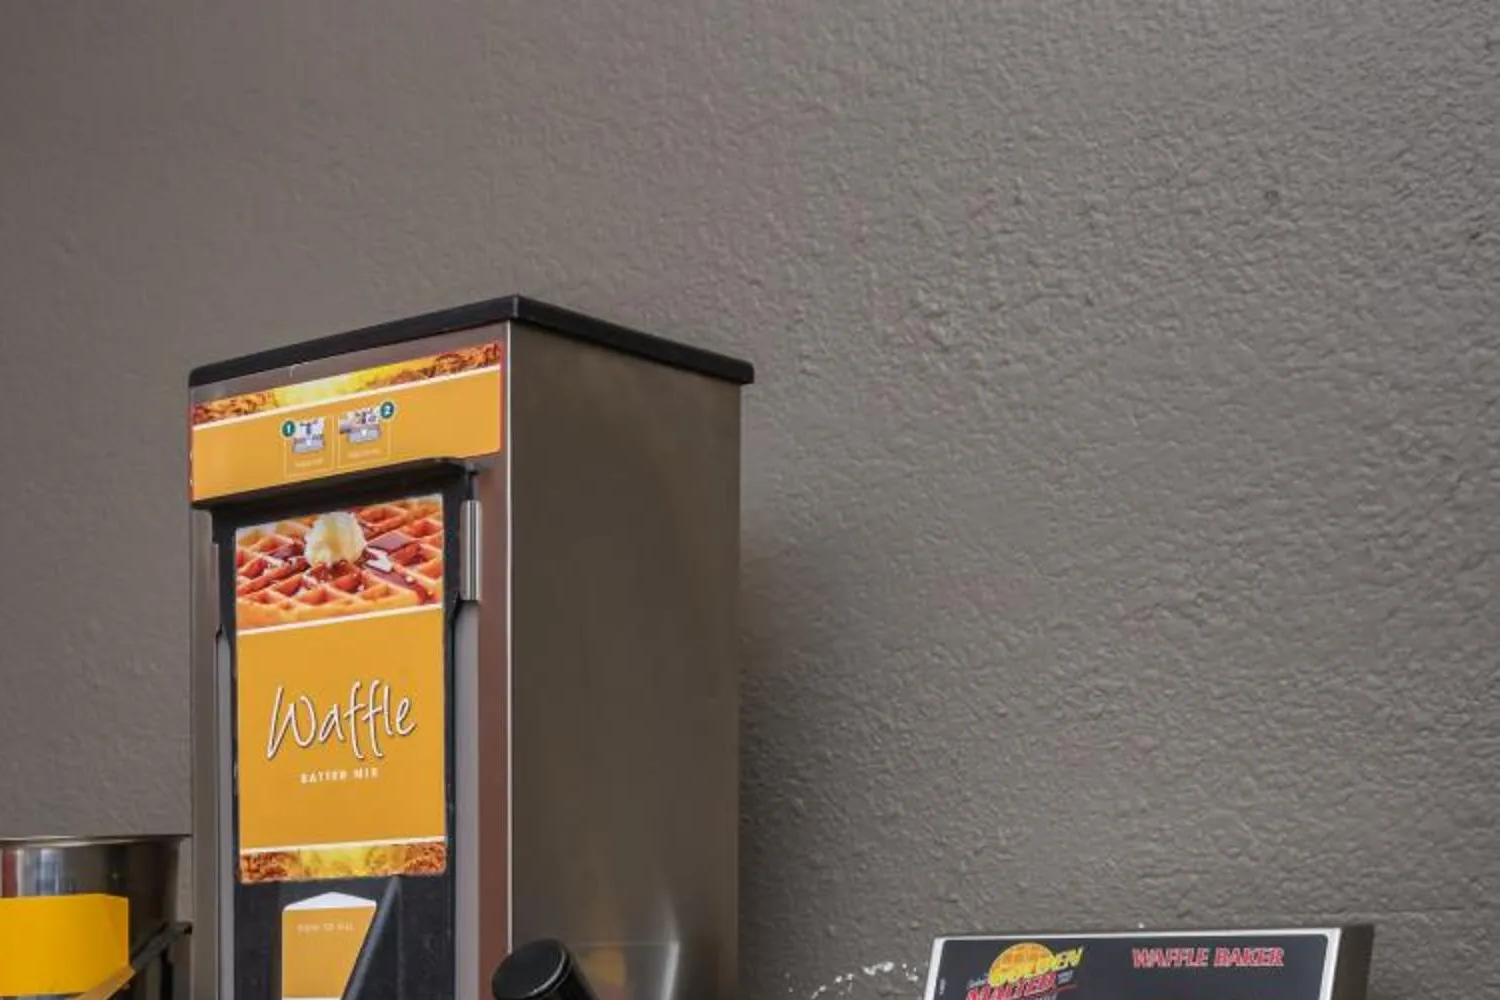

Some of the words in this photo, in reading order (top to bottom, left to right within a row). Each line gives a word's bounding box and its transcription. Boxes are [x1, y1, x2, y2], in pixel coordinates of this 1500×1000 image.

[267, 679, 416, 760] Waffle
[1132, 947, 1209, 969] WAFFLE
[1213, 946, 1285, 968] BAKER
